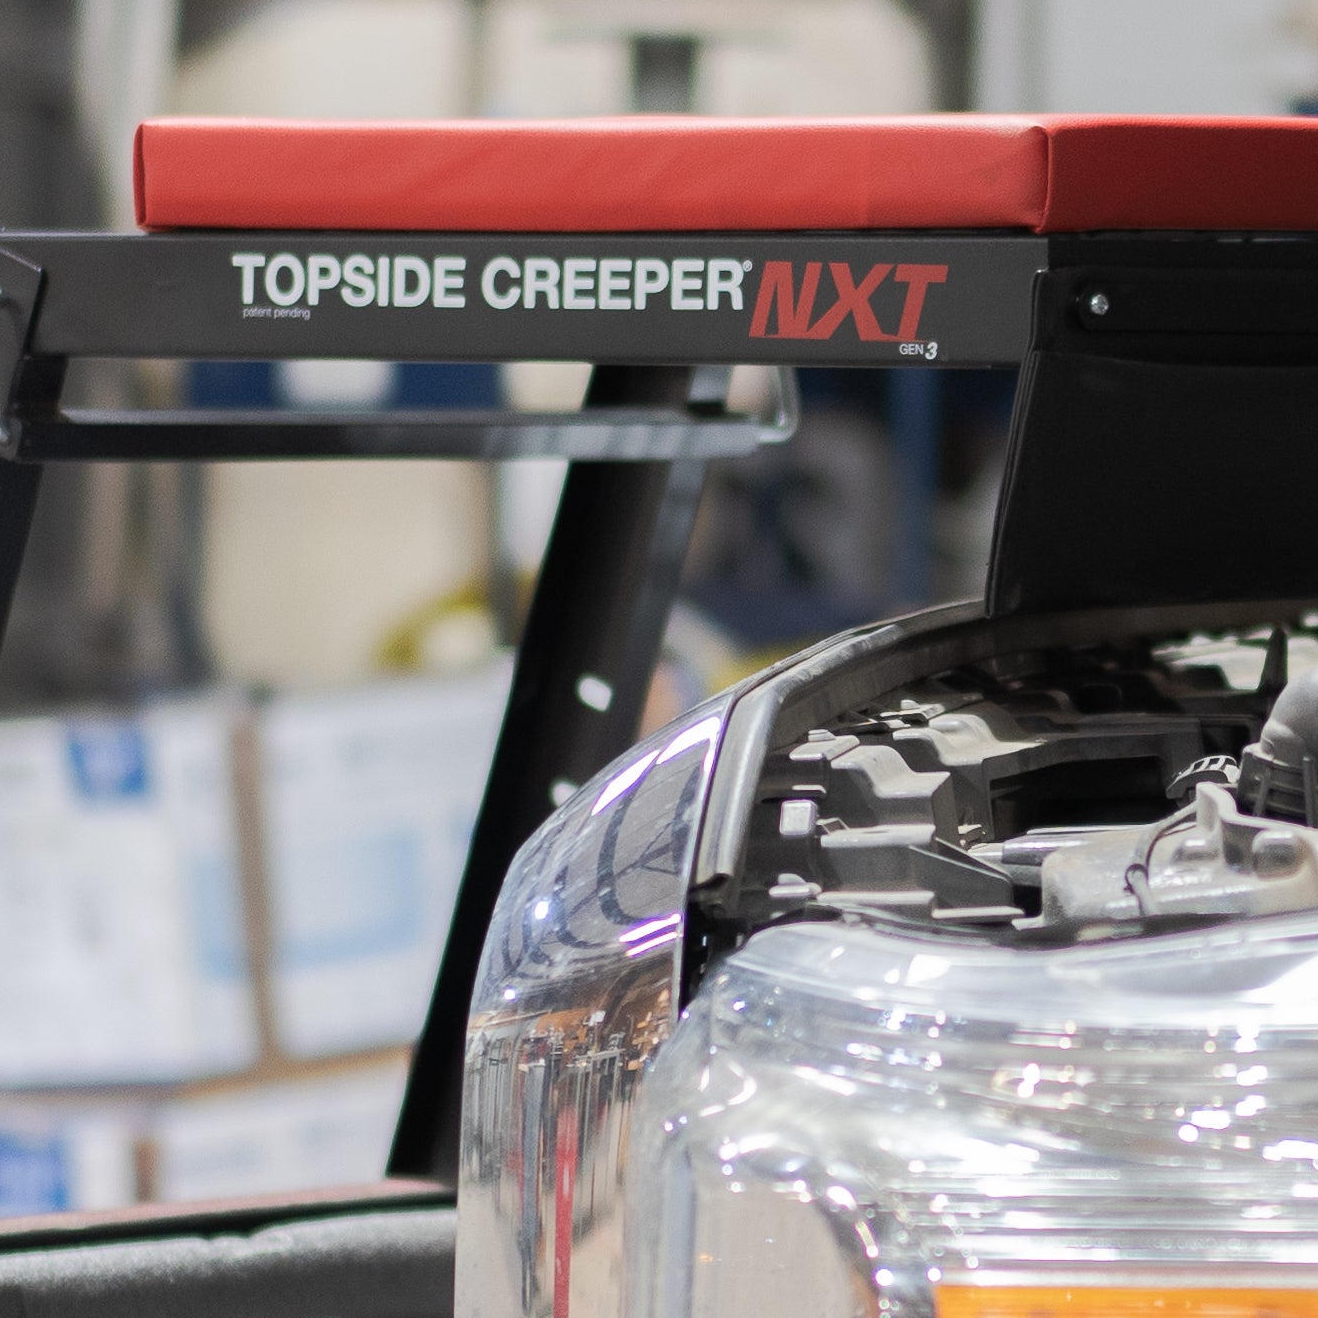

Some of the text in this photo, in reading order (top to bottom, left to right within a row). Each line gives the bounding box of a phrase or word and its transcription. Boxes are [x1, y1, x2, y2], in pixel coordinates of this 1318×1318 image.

[231, 253, 467, 308] TOPSIDE
[749, 260, 949, 343] NXT
[243, 307, 311, 321] patent pending
[898, 341, 939, 360] GEN 3
